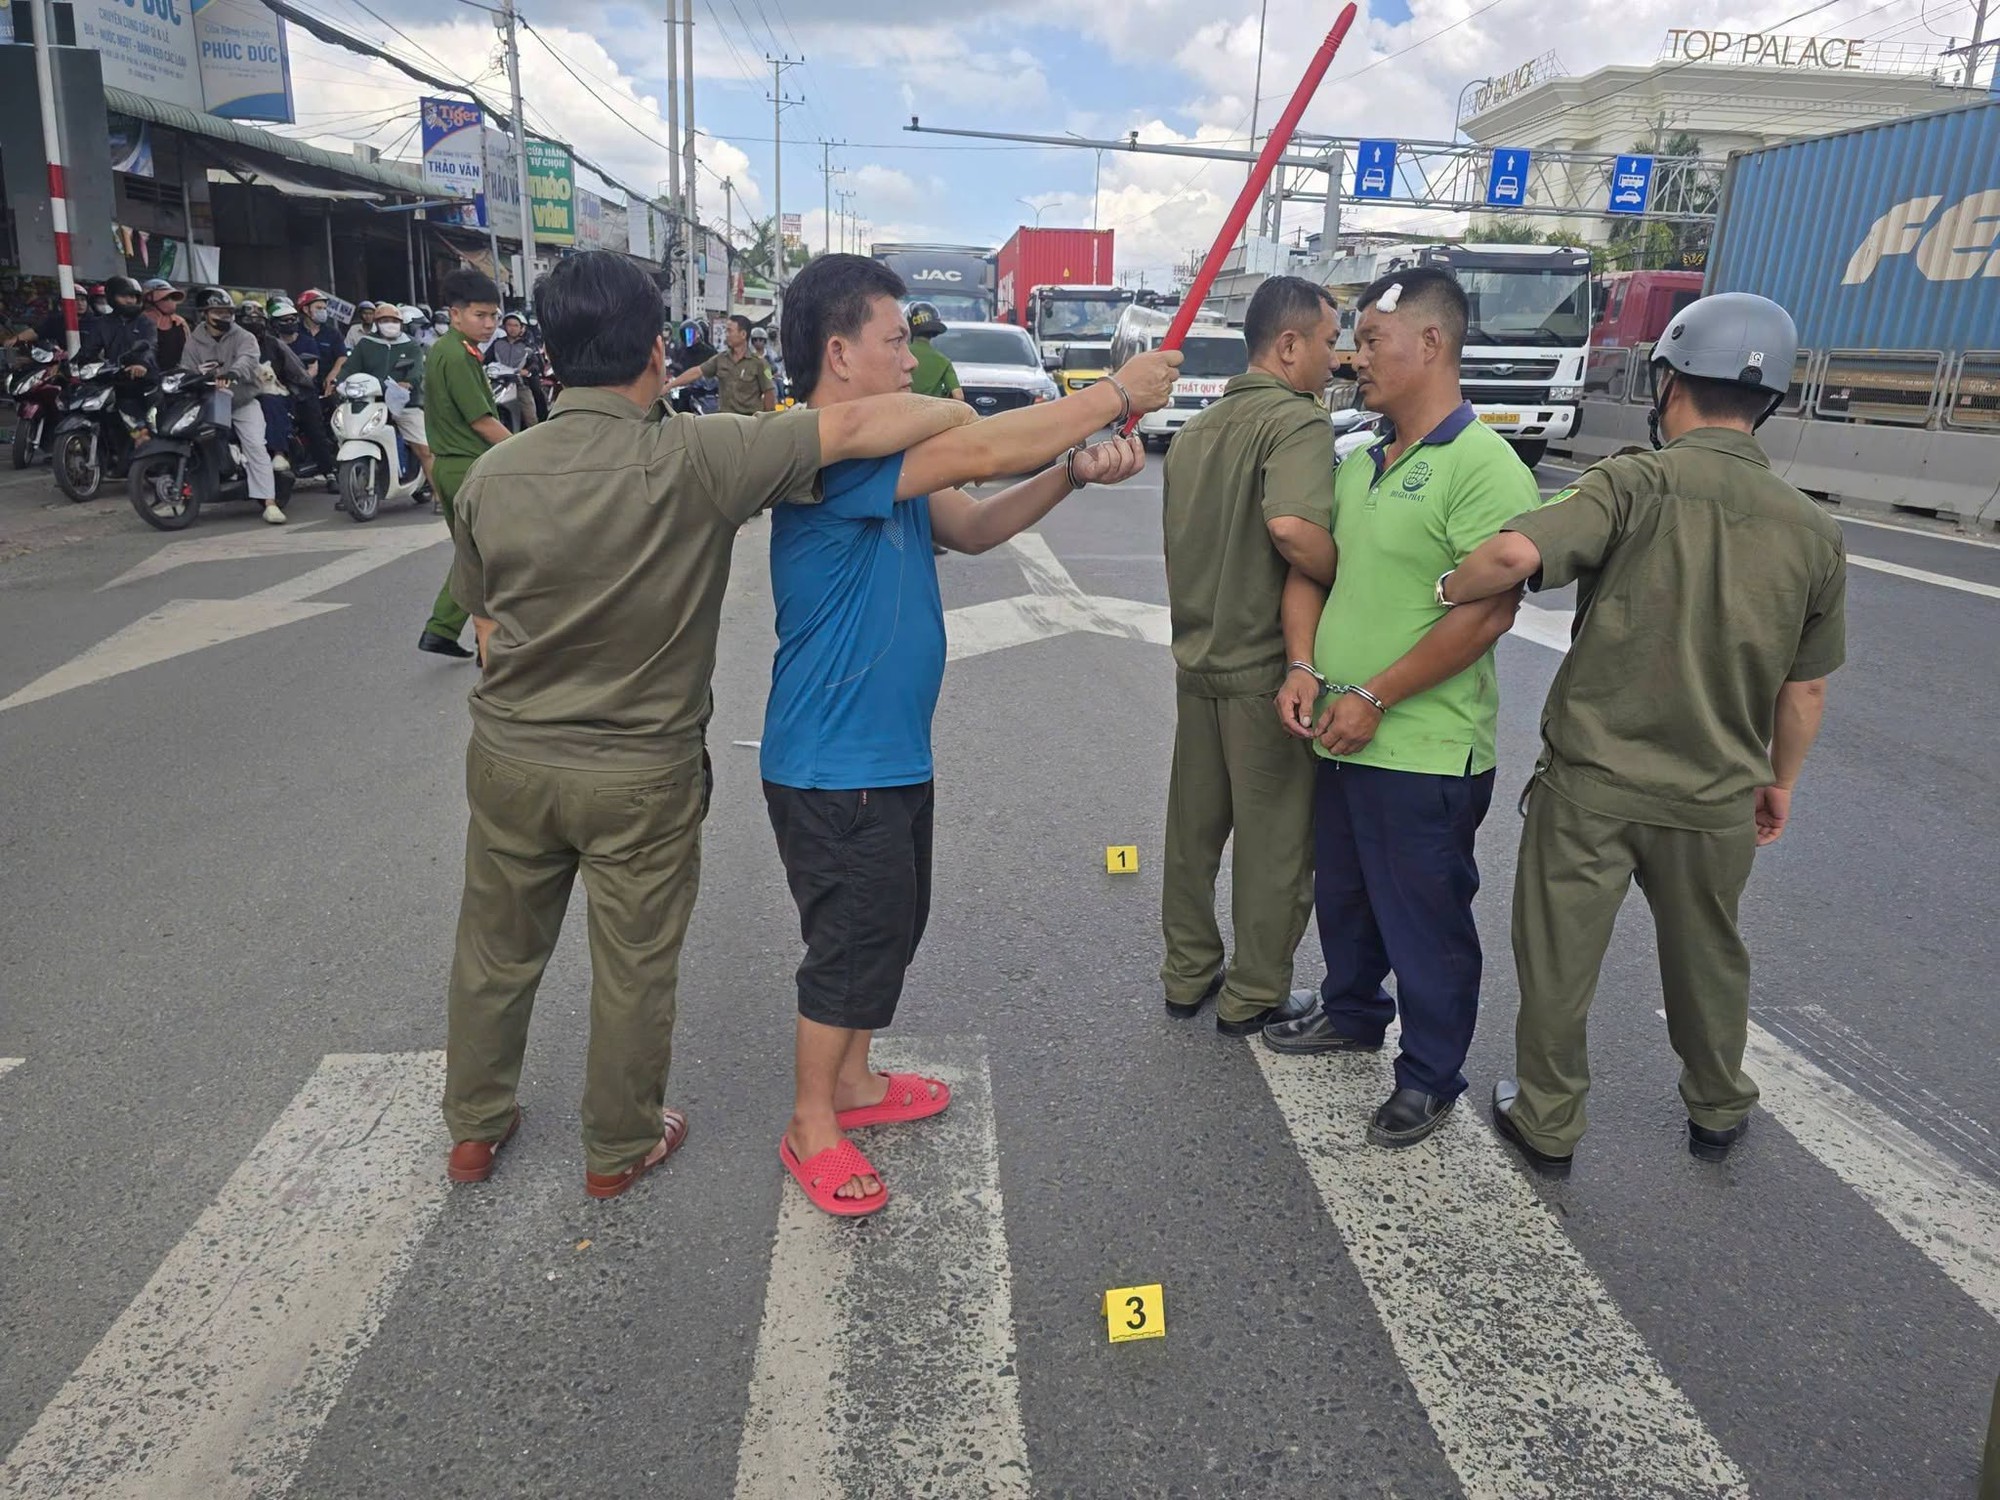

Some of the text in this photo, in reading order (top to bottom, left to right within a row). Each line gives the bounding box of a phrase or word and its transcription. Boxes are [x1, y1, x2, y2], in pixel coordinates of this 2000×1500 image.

[202, 38, 242, 61] PHÚC
[1668, 29, 1865, 69] TOP PALACE
[439, 105, 479, 127] Tiger
[427, 158, 456, 175] THẢO
[488, 166, 508, 203] HẢO
[528, 170, 571, 201] THẢO
[1841, 188, 2000, 285] FE
[912, 269, 962, 281] JAC
[1117, 851, 1126, 868] 1
[1125, 1296, 1147, 1330] 3
